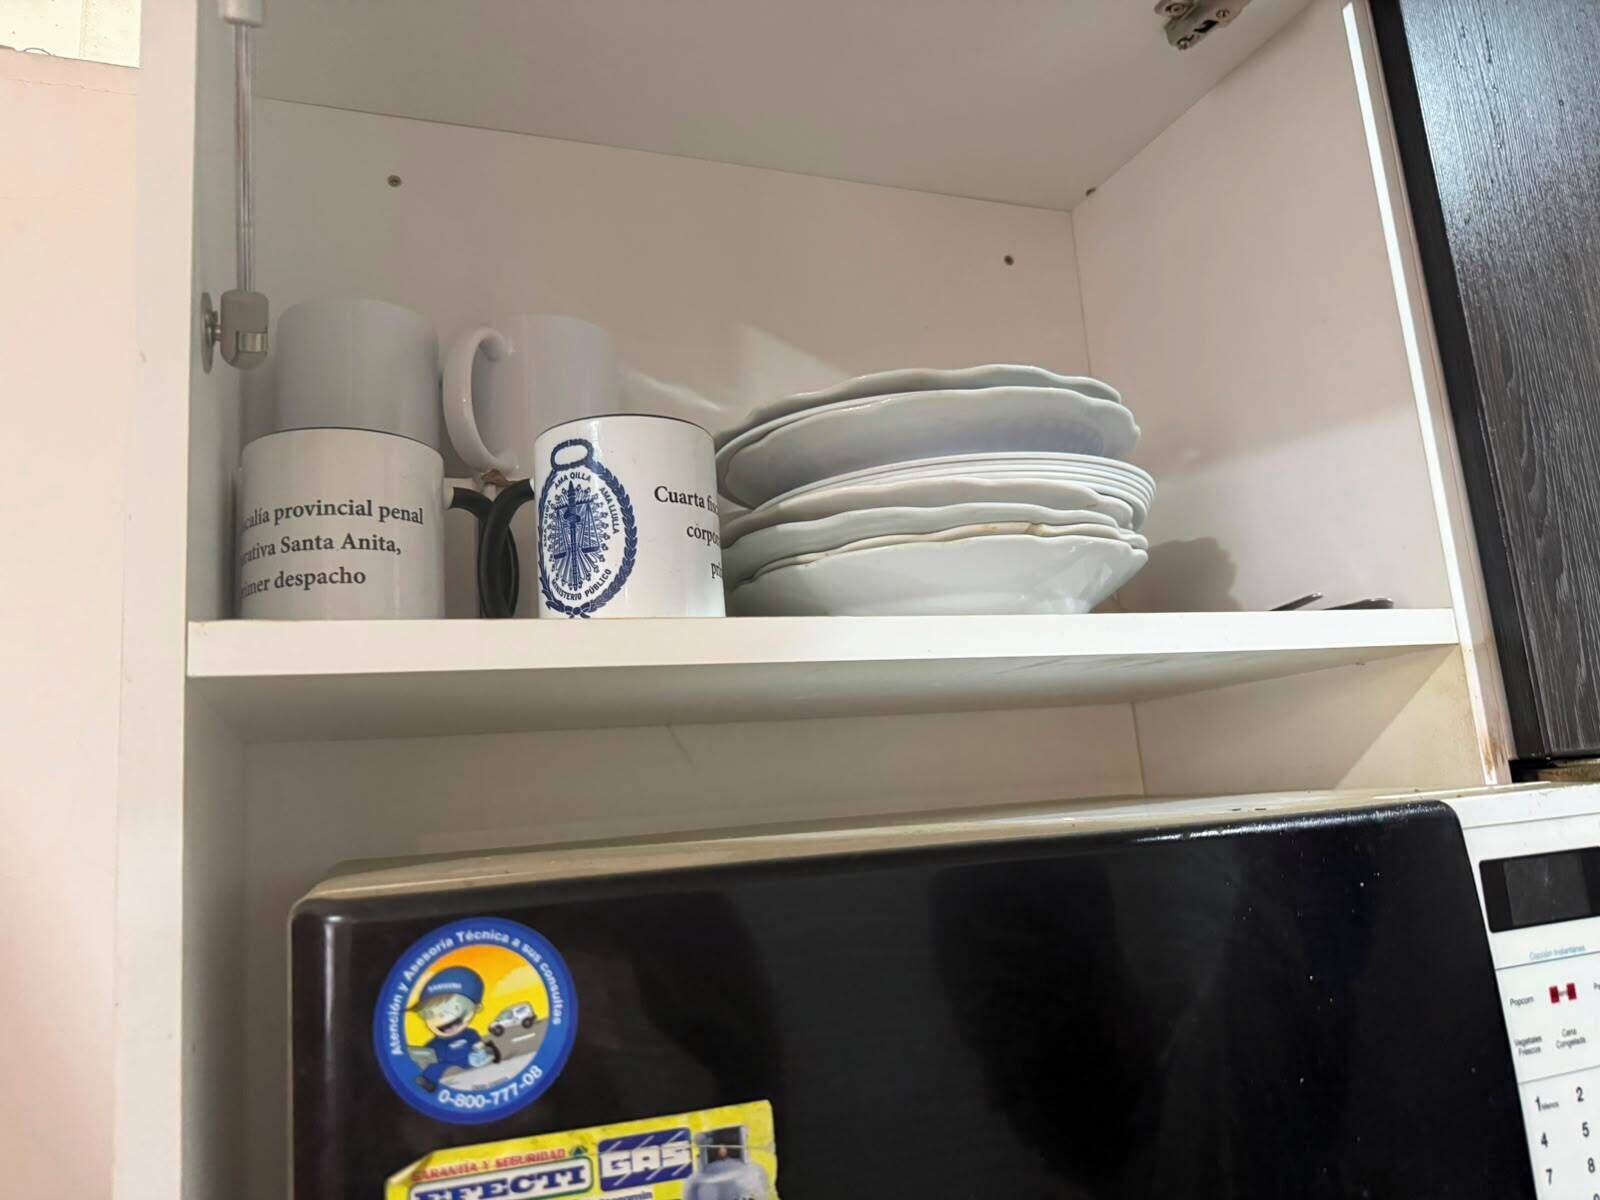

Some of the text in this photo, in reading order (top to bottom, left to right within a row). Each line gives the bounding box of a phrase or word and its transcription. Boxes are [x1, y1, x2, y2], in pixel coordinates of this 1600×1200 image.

[555, 474, 569, 490] AMA
[600, 487, 613, 504] AMA
[654, 486, 706, 509] Cuarta
[274, 499, 373, 526] provincial
[378, 504, 424, 525] penal
[280, 536, 334, 554] Santa
[340, 533, 402, 555] Anita,
[274, 566, 366, 590] despacho
[551, 568, 612, 601] MINISTERIO PÚBLICO
[387, 928, 564, 1055] Atención y Asesoría Técnica a sus consultas
[437, 1064, 544, 1109] 0-800-777-08
[1576, 1086, 1584, 1102] 2
[1535, 1096, 1541, 1111] 1
[1582, 1121, 1590, 1138] 5
[1541, 1132, 1548, 1148] 4
[600, 1140, 691, 1178] GAS
[1587, 1157, 1595, 1173] 8
[1545, 1168, 1552, 1185] 7
